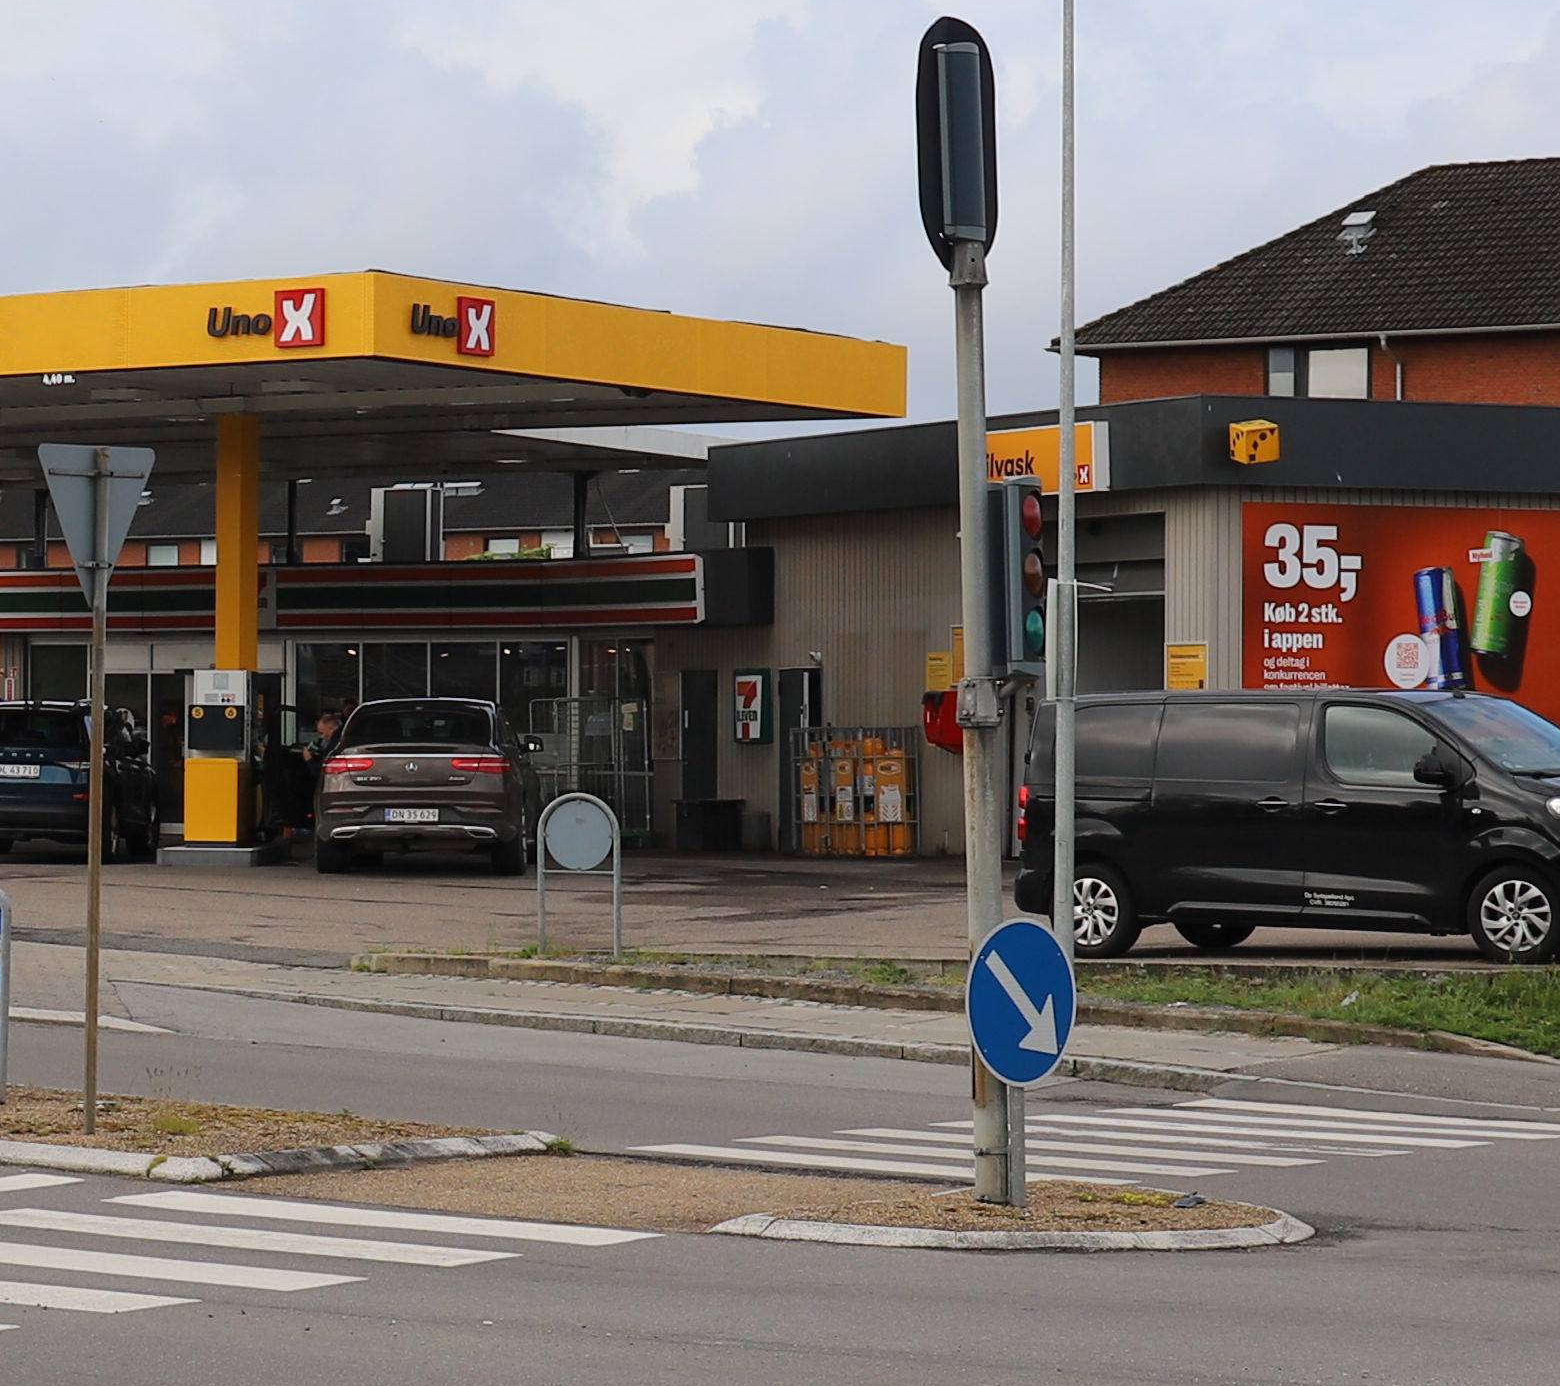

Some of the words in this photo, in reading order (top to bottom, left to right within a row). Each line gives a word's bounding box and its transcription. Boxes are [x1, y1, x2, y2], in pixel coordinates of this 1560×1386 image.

[207, 307, 272, 338] Uno
[280, 293, 316, 342] X
[411, 303, 460, 338] Uno
[466, 304, 492, 351] X
[986, 449, 1035, 478] ilvask
[1264, 602, 1296, 623] Køb
[1298, 603, 1309, 622] 2
[1311, 603, 1343, 623] stk.
[1264, 629, 1270, 648] i
[1272, 632, 1323, 652] appen
[1264, 658, 1275, 668] og
[1276, 656, 1305, 669] deltag
[1264, 669, 1326, 680] konkurrencen
[737, 680, 757, 740] 7
